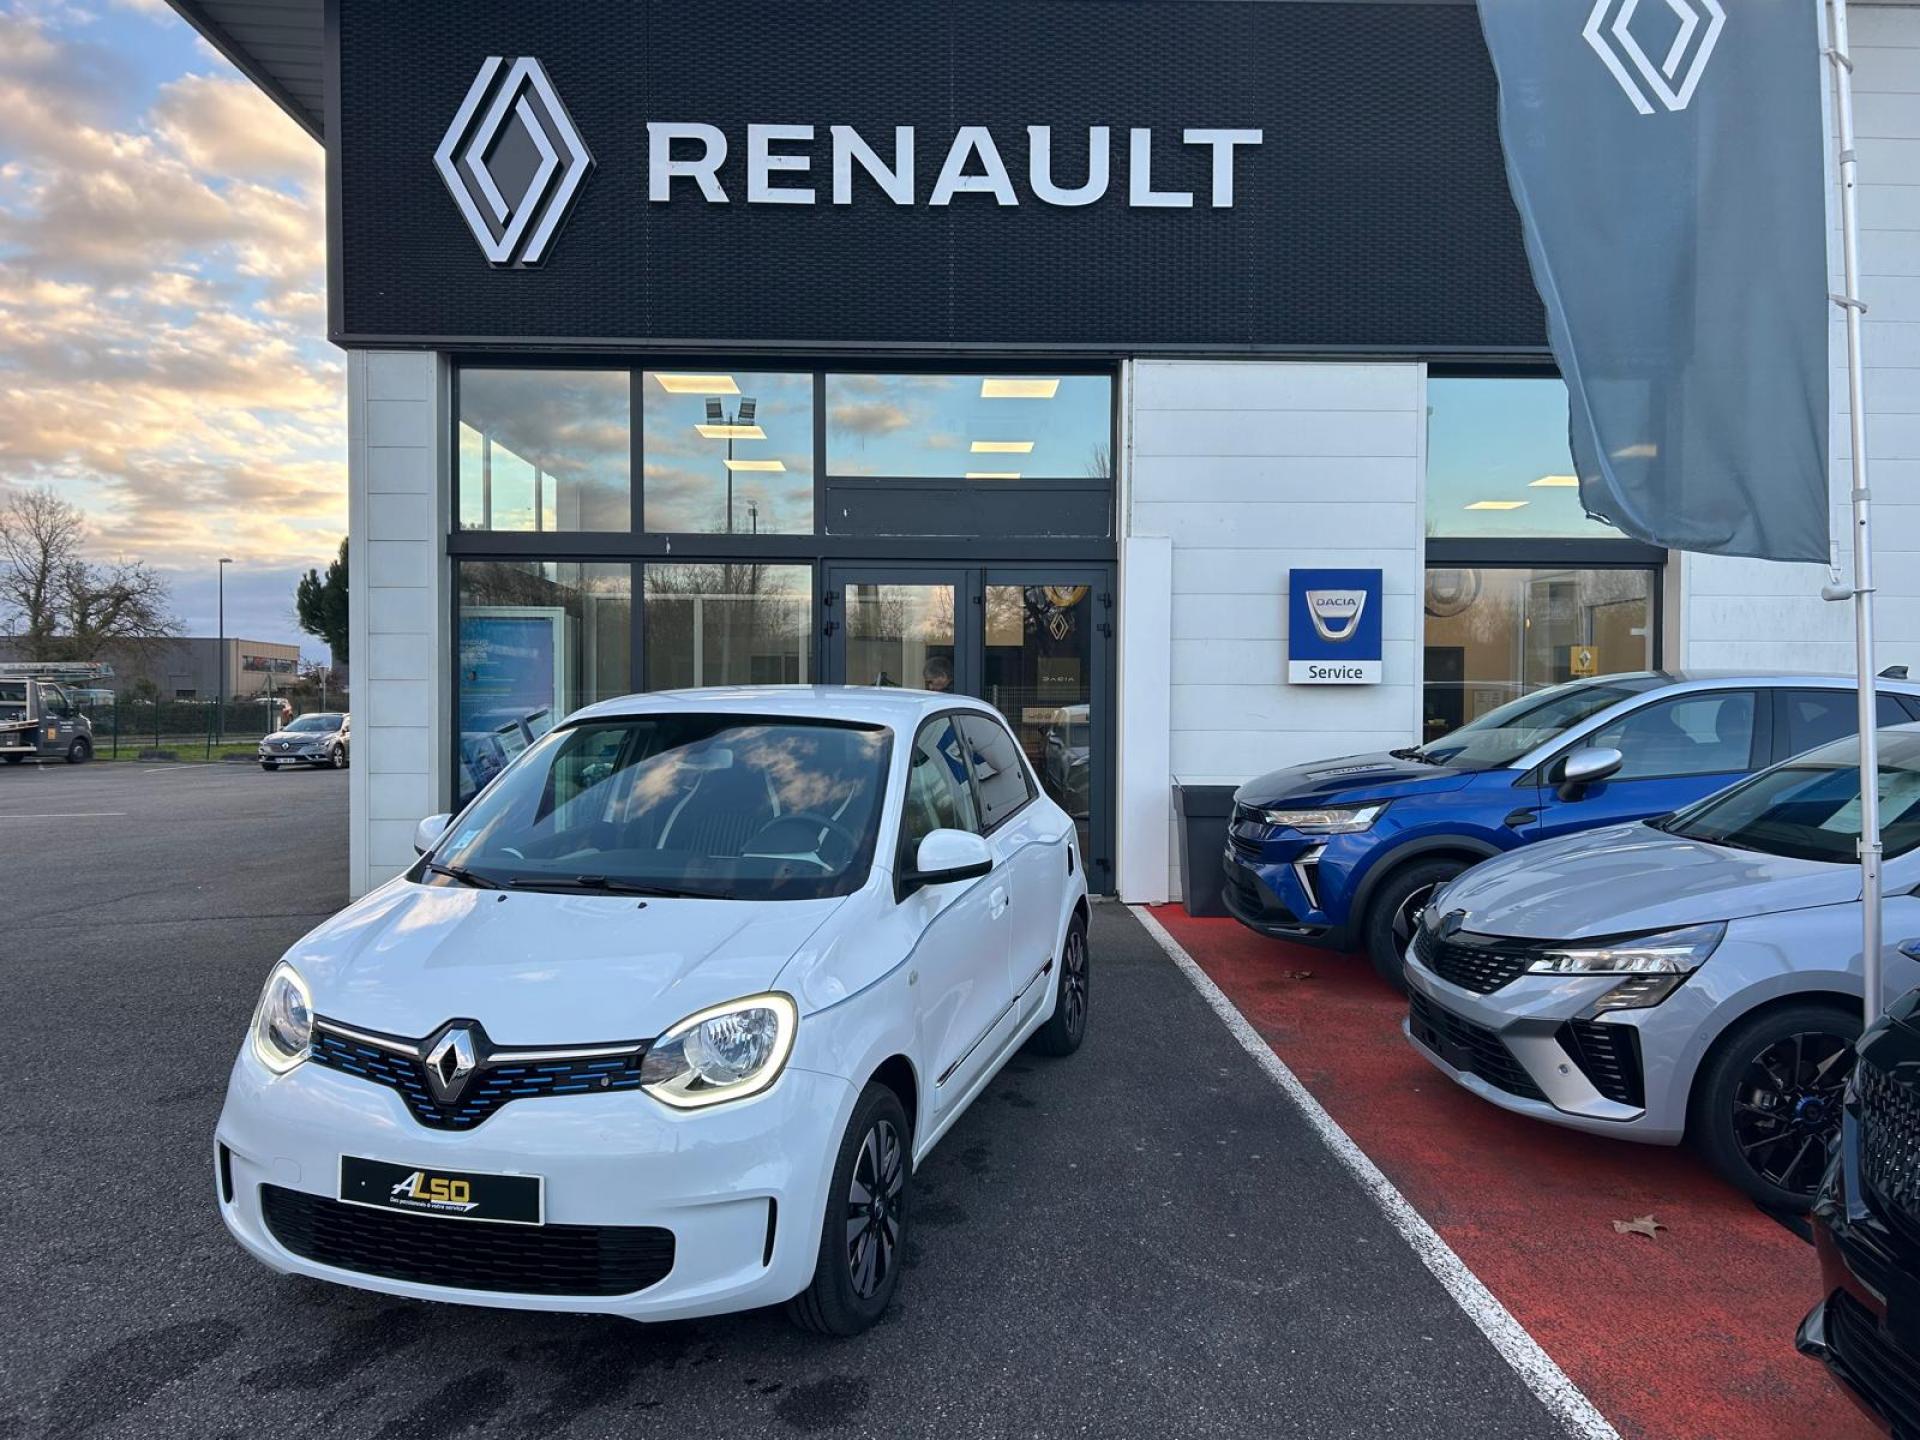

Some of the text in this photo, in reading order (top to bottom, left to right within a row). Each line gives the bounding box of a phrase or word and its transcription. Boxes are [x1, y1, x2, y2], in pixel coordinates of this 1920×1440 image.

[645, 121, 1264, 208] RENAULT
[1316, 597, 1357, 607] DACIA
[1308, 665, 1363, 679] Service
[390, 1170, 470, 1203] ALSO
